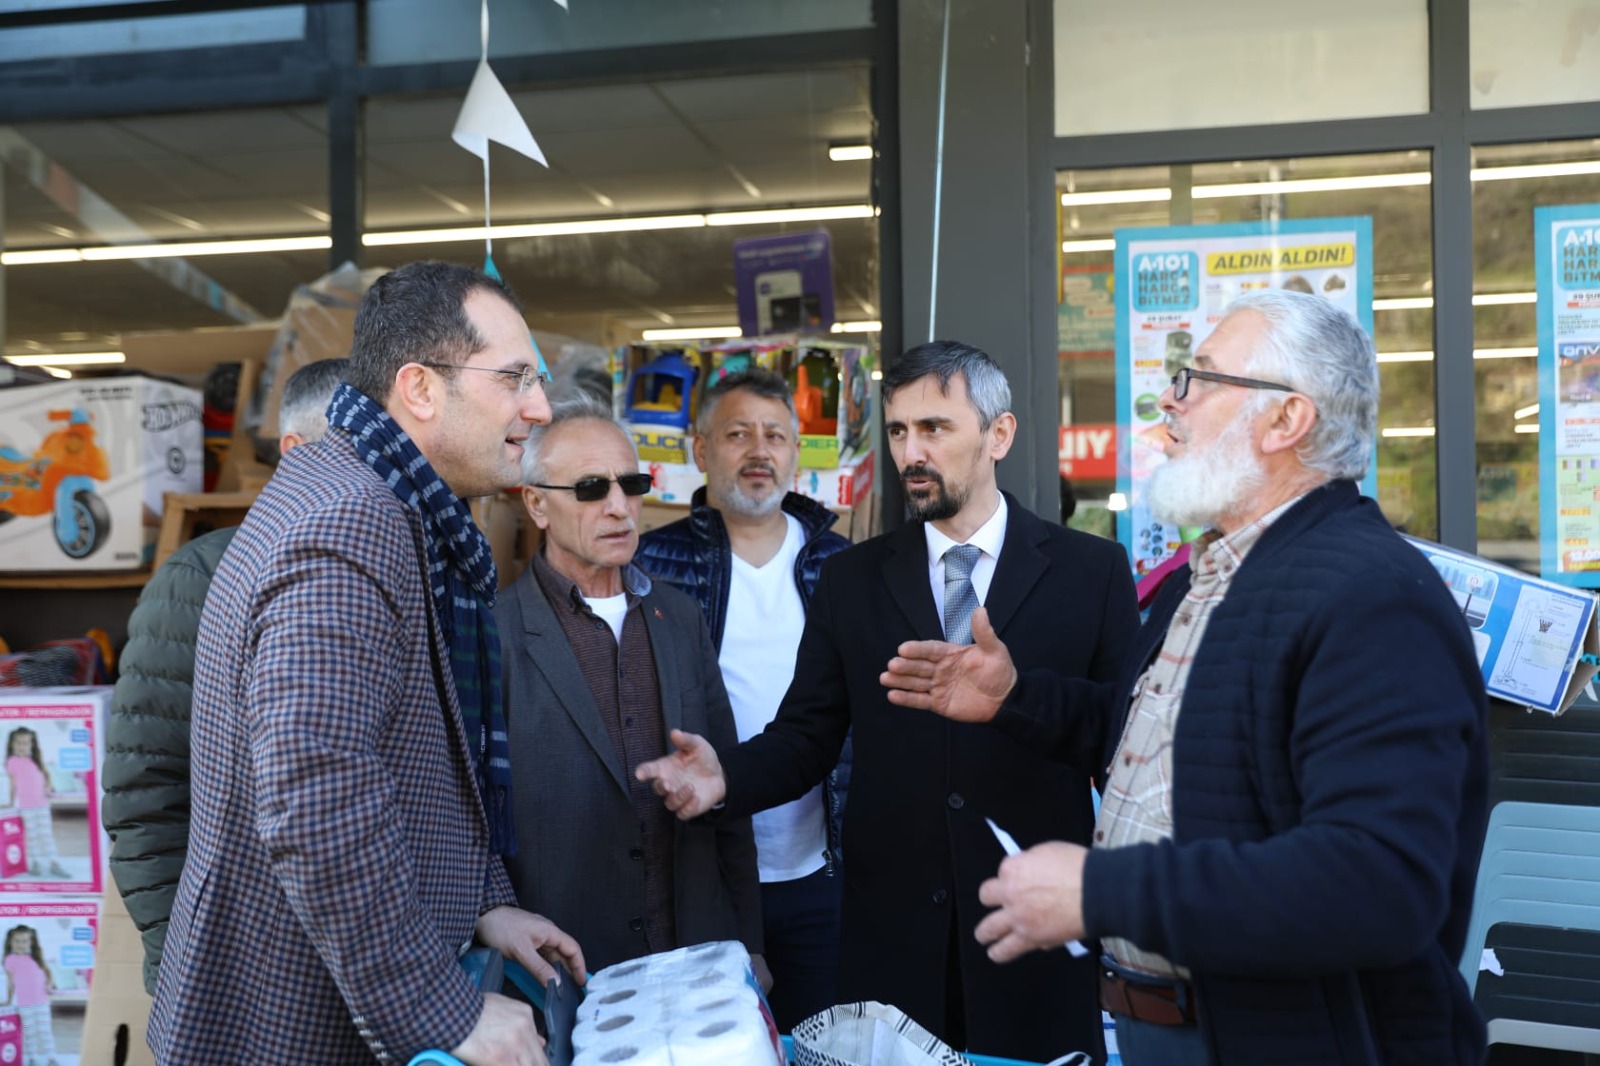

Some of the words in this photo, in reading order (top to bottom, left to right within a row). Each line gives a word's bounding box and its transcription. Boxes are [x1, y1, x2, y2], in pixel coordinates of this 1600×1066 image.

[1213, 252, 1273, 271] ALDIN
[1278, 246, 1347, 267] ALDIN!
[798, 436, 840, 449] DIER
